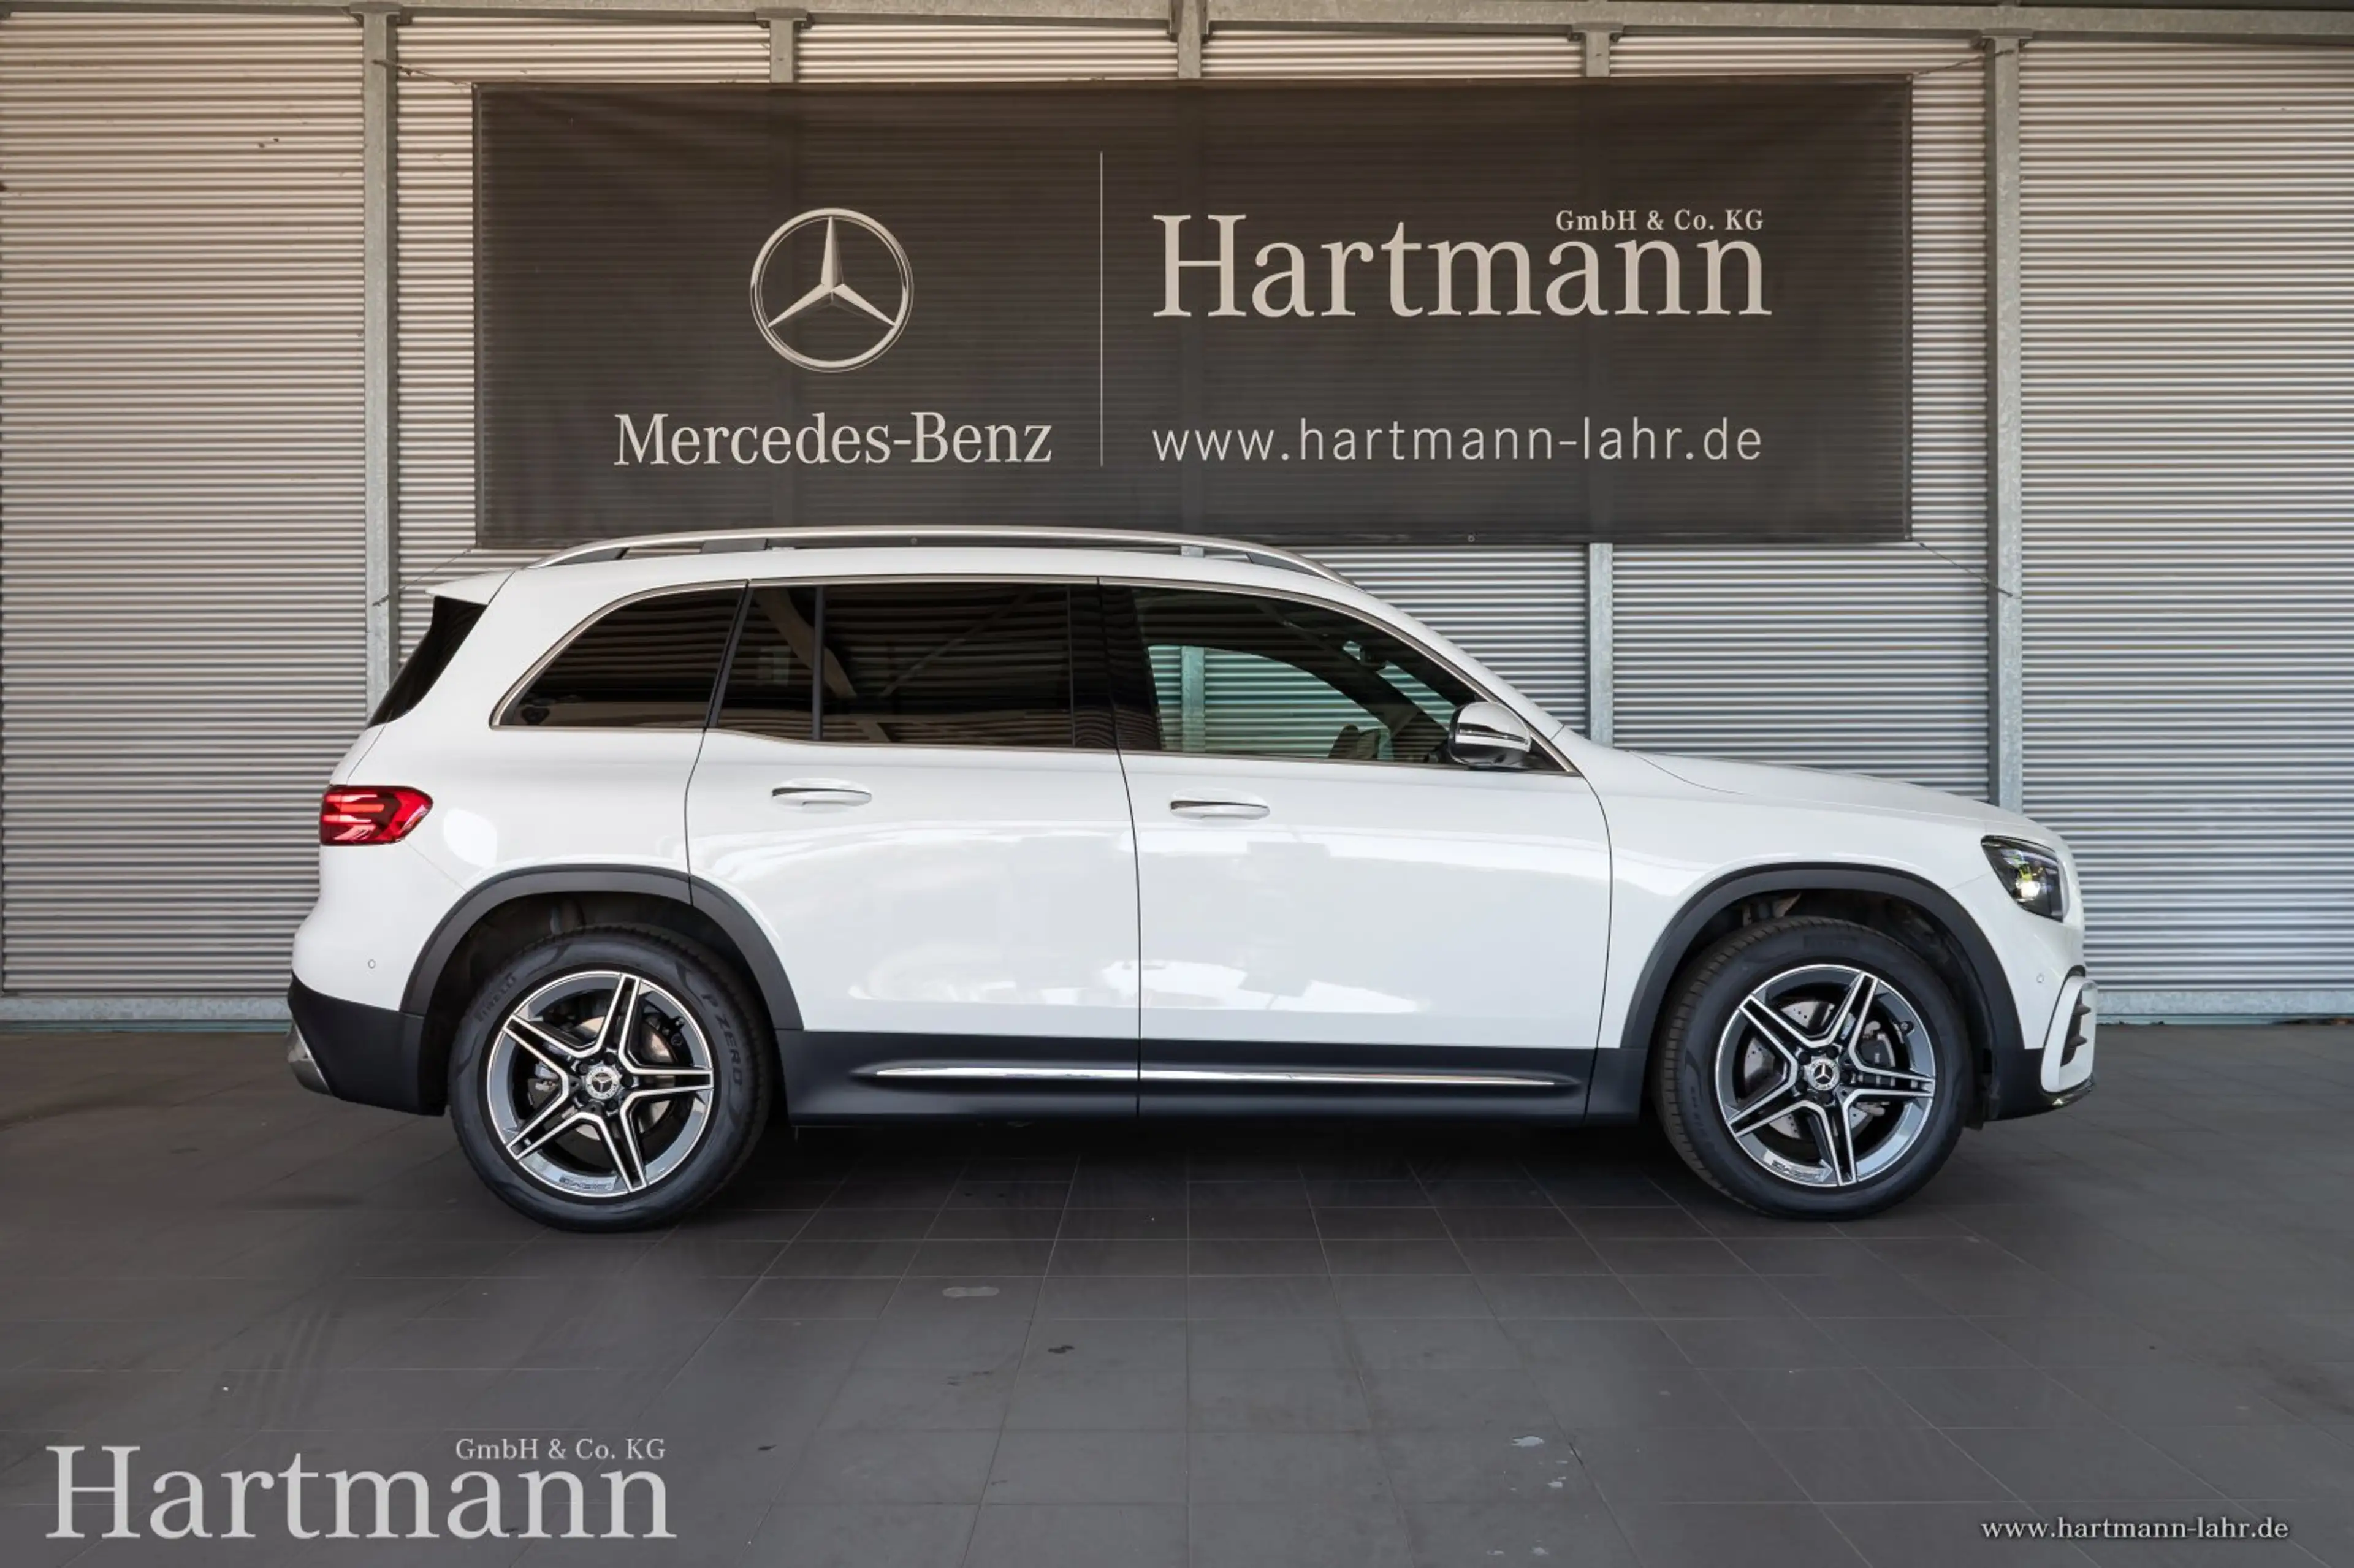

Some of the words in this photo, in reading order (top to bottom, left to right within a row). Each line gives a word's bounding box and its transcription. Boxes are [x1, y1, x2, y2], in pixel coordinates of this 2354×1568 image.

[1556, 209, 1636, 231] GmbH
[1647, 210, 1664, 231] &
[1674, 209, 1715, 231] Co.
[1726, 209, 1763, 231] KG
[1152, 213, 1773, 318] Hartmann
[614, 411, 1052, 466] Mercedes-Benz
[1152, 416, 1761, 462] www.hartmann-lahr.de
